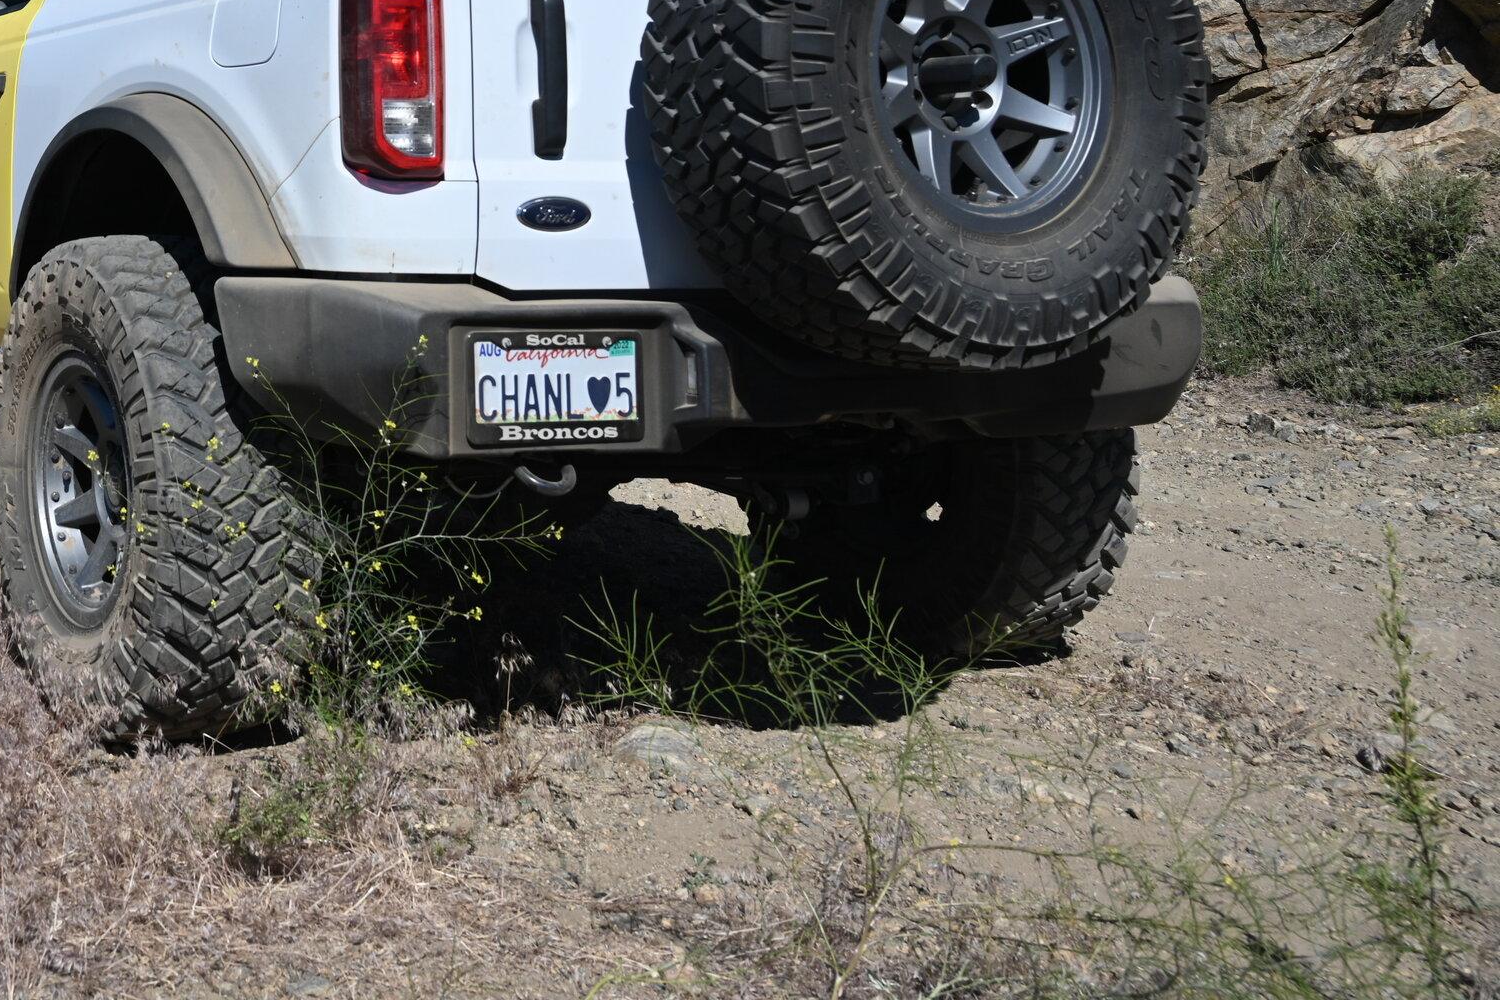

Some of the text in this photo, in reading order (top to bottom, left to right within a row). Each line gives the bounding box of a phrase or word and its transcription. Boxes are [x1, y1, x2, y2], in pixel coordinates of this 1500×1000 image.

[1006, 25, 1055, 56] ICON
[1067, 166, 1150, 262] TRAIL
[525, 334, 586, 346] SoCal
[479, 343, 502, 357] AUG
[505, 348, 609, 368] California
[499, 425, 619, 441] Broncos
